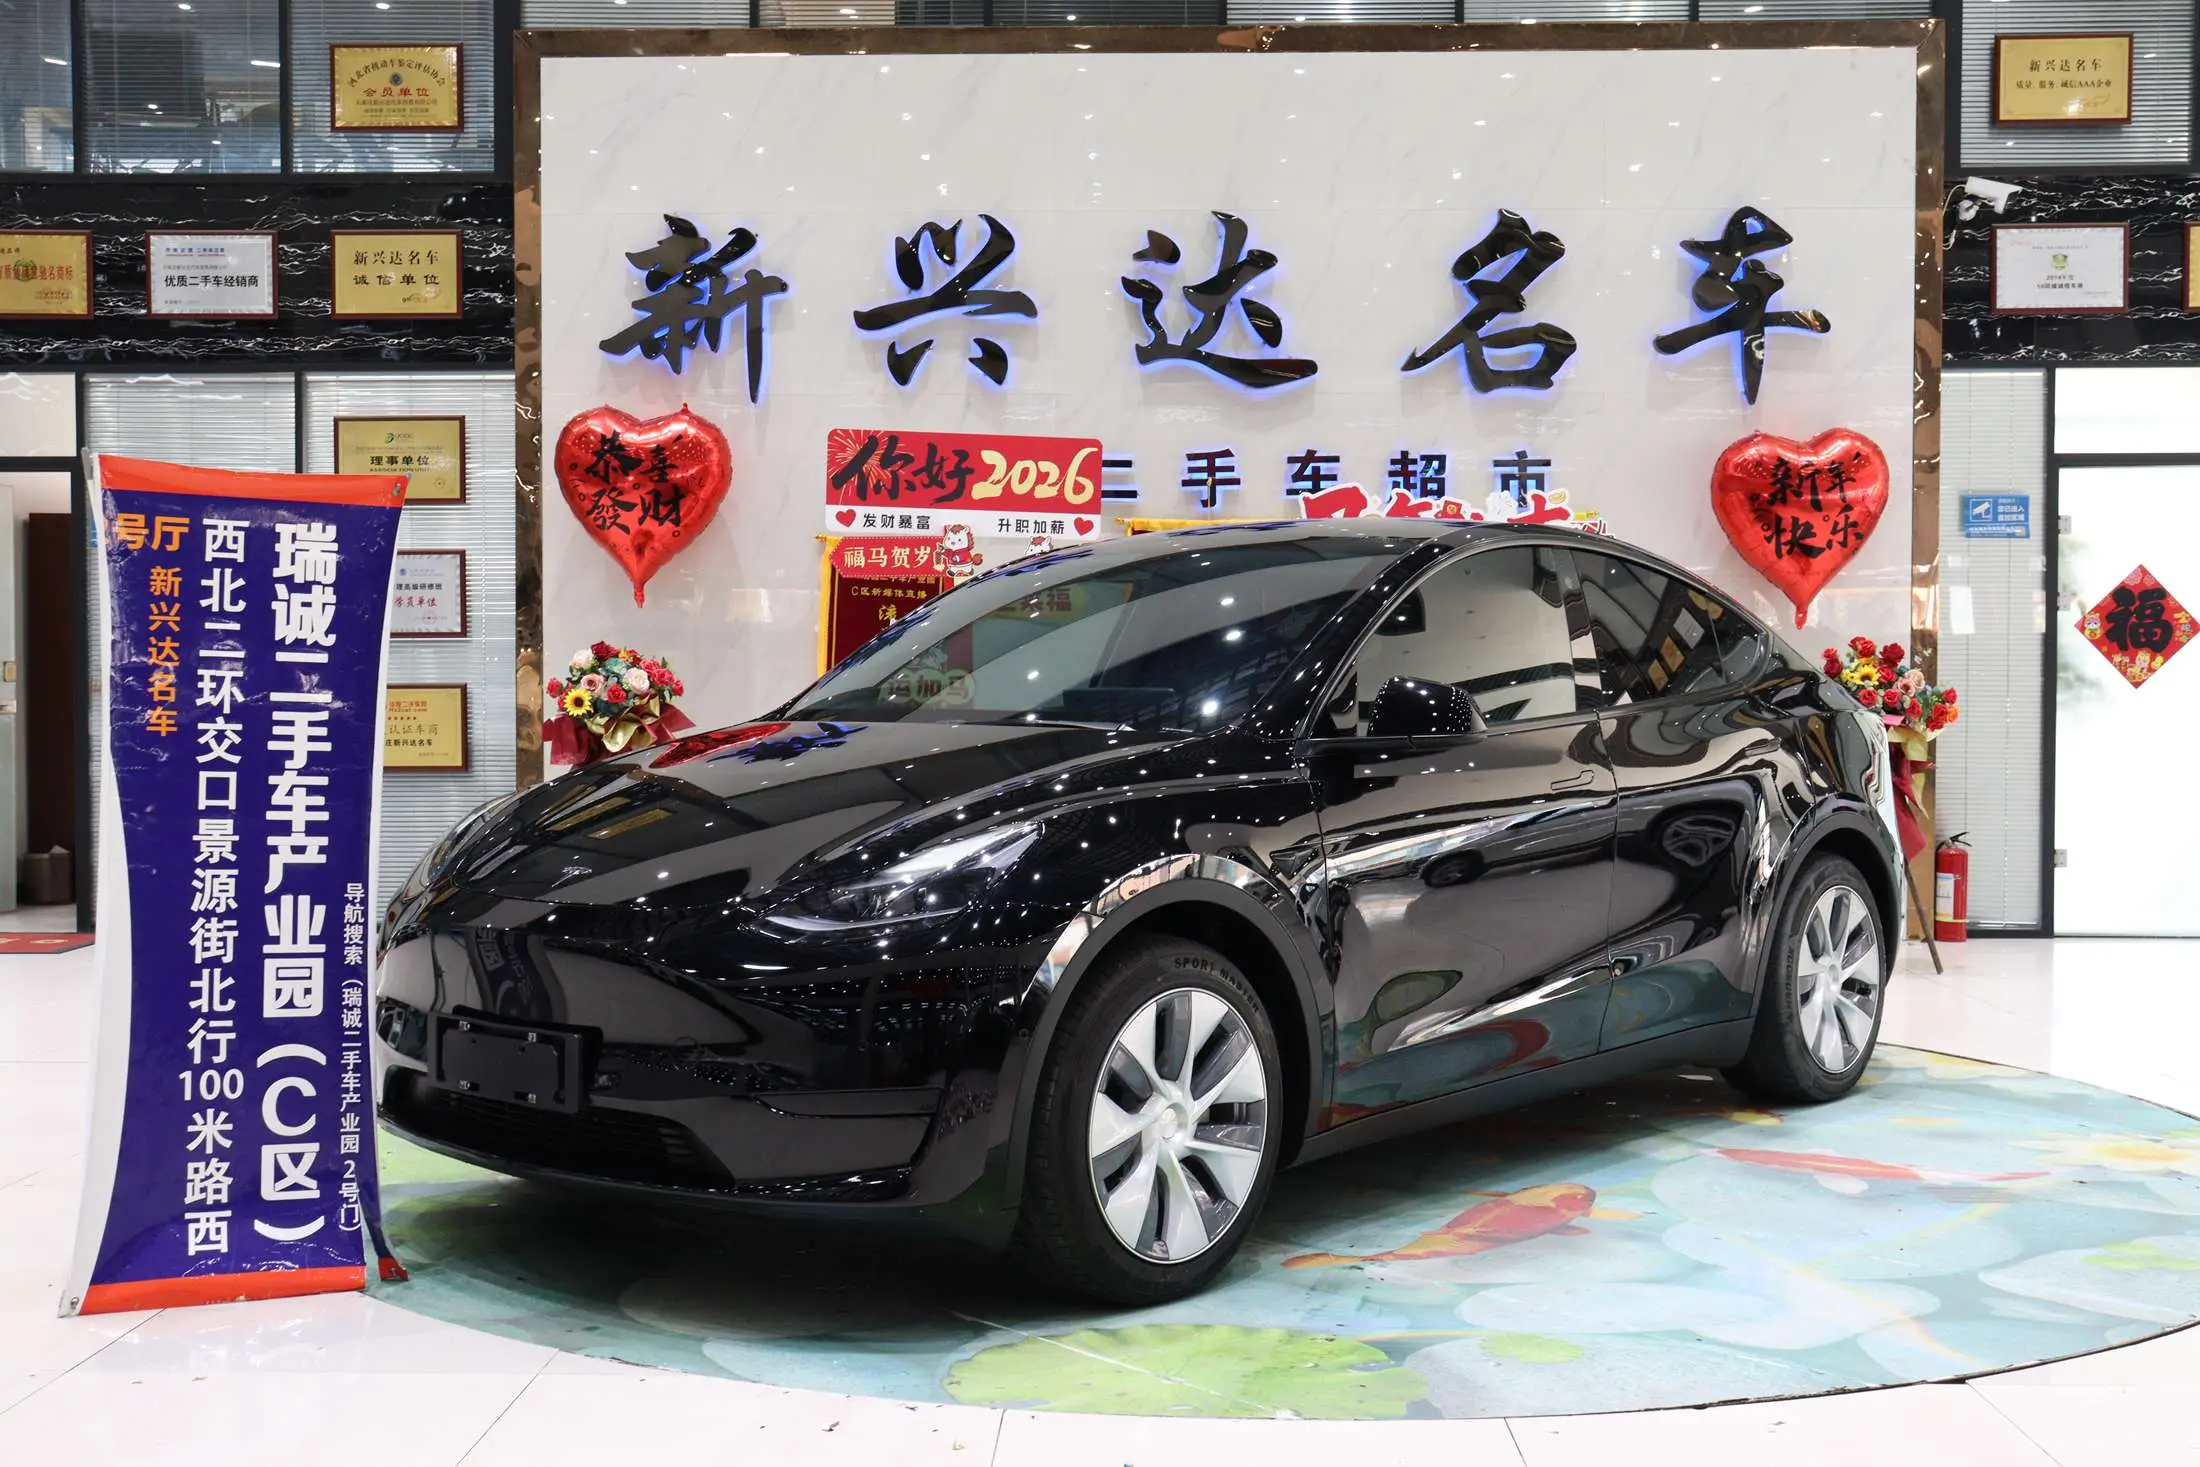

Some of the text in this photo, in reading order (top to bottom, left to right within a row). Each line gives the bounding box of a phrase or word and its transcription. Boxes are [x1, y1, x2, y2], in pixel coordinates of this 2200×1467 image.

[2030, 59, 2102, 72] 新兴达名车
[363, 87, 429, 98] 会员单位
[353, 250, 439, 265] 新兴达名车
[164, 274, 259, 287] 优质二手车经销商
[353, 275, 439, 286] 诚信单位
[599, 206, 1831, 405] 新兴达名车
[370, 455, 430, 466] 理事单位
[584, 430, 678, 484] 恭喜
[831, 435, 1098, 505] 你好 2026
[1768, 456, 1856, 512] 新年
[863, 512, 1065, 535] 发财暴富 升职加薪
[1764, 504, 1864, 559] 快乐
[843, 545, 932, 568] 福马贺岁
[851, 586, 927, 599] C区新媒体直播
[2105, 586, 2173, 654] 福
[146, 565, 183, 737] 新兴达名车
[179, 518, 250, 1256] 西北二环交口景源街北行100米路西
[1174, 957, 1215, 972] SPORT
